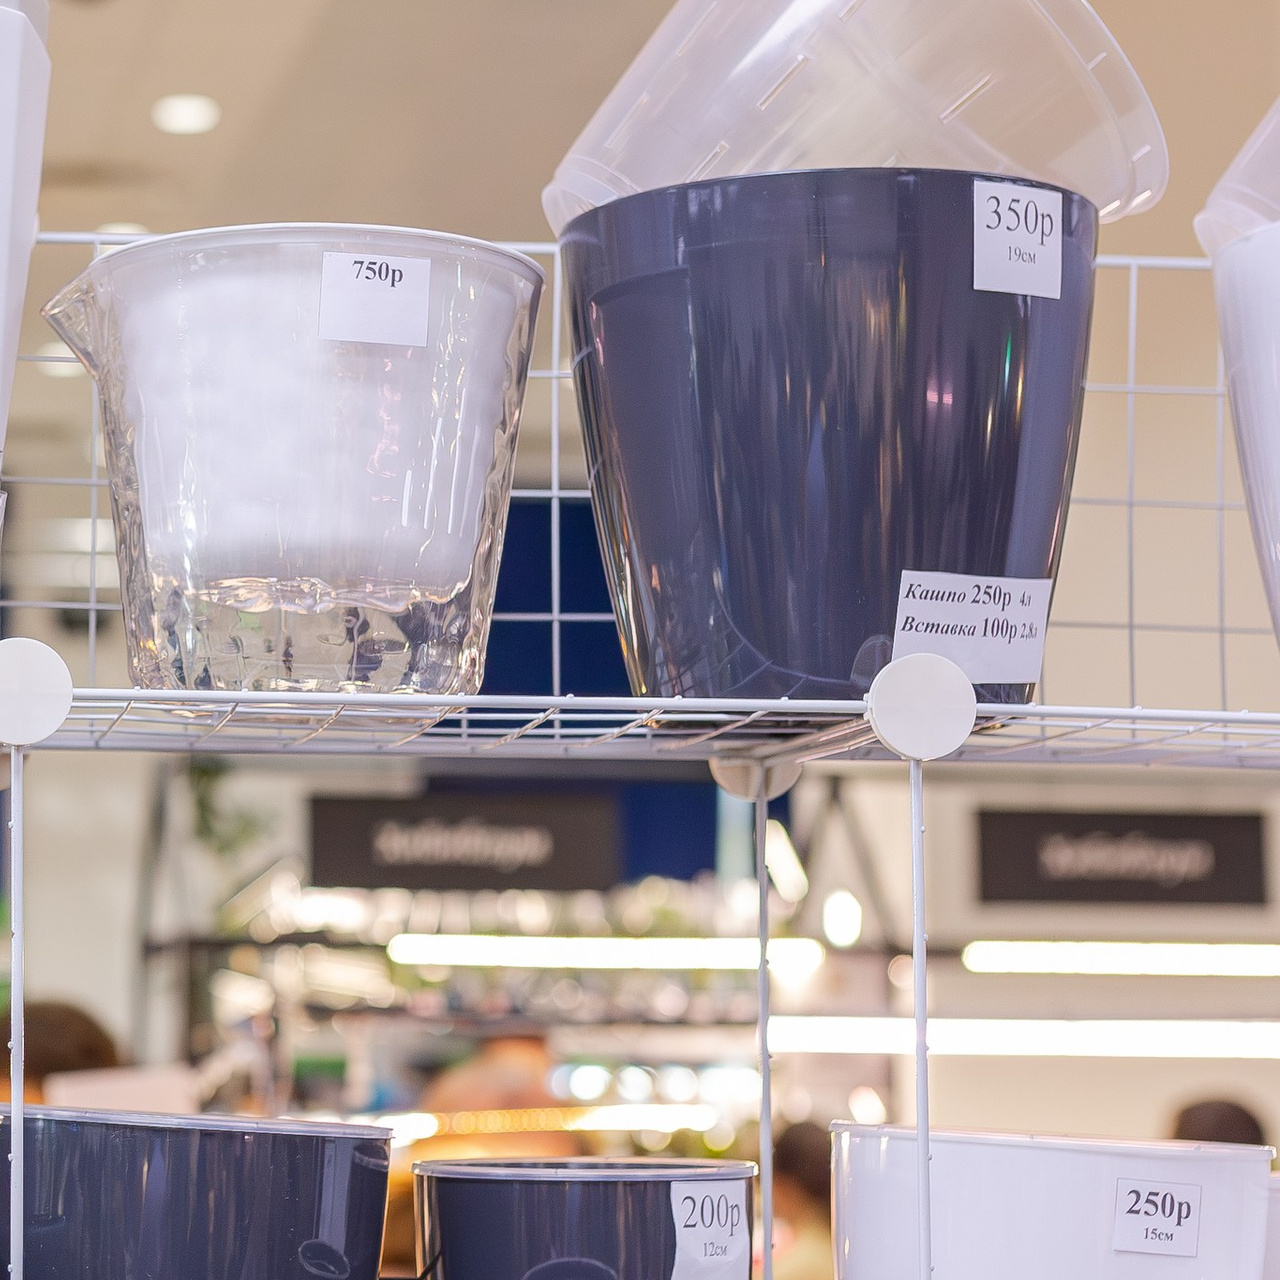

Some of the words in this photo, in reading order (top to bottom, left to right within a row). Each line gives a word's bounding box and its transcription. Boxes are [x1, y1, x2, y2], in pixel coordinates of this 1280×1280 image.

[985, 195, 1054, 247] 350р
[1007, 245, 1036, 265] 19см
[352, 259, 404, 288] 750р
[903, 582, 967, 604] Кашпо
[969, 583, 1012, 612] 250р
[900, 615, 977, 638] Вставка
[980, 617, 1018, 645] 100р
[681, 1194, 741, 1238] 200р
[1125, 1189, 1192, 1227] 250р
[1143, 1226, 1175, 1242] 15см
[703, 1241, 729, 1258] 12см
